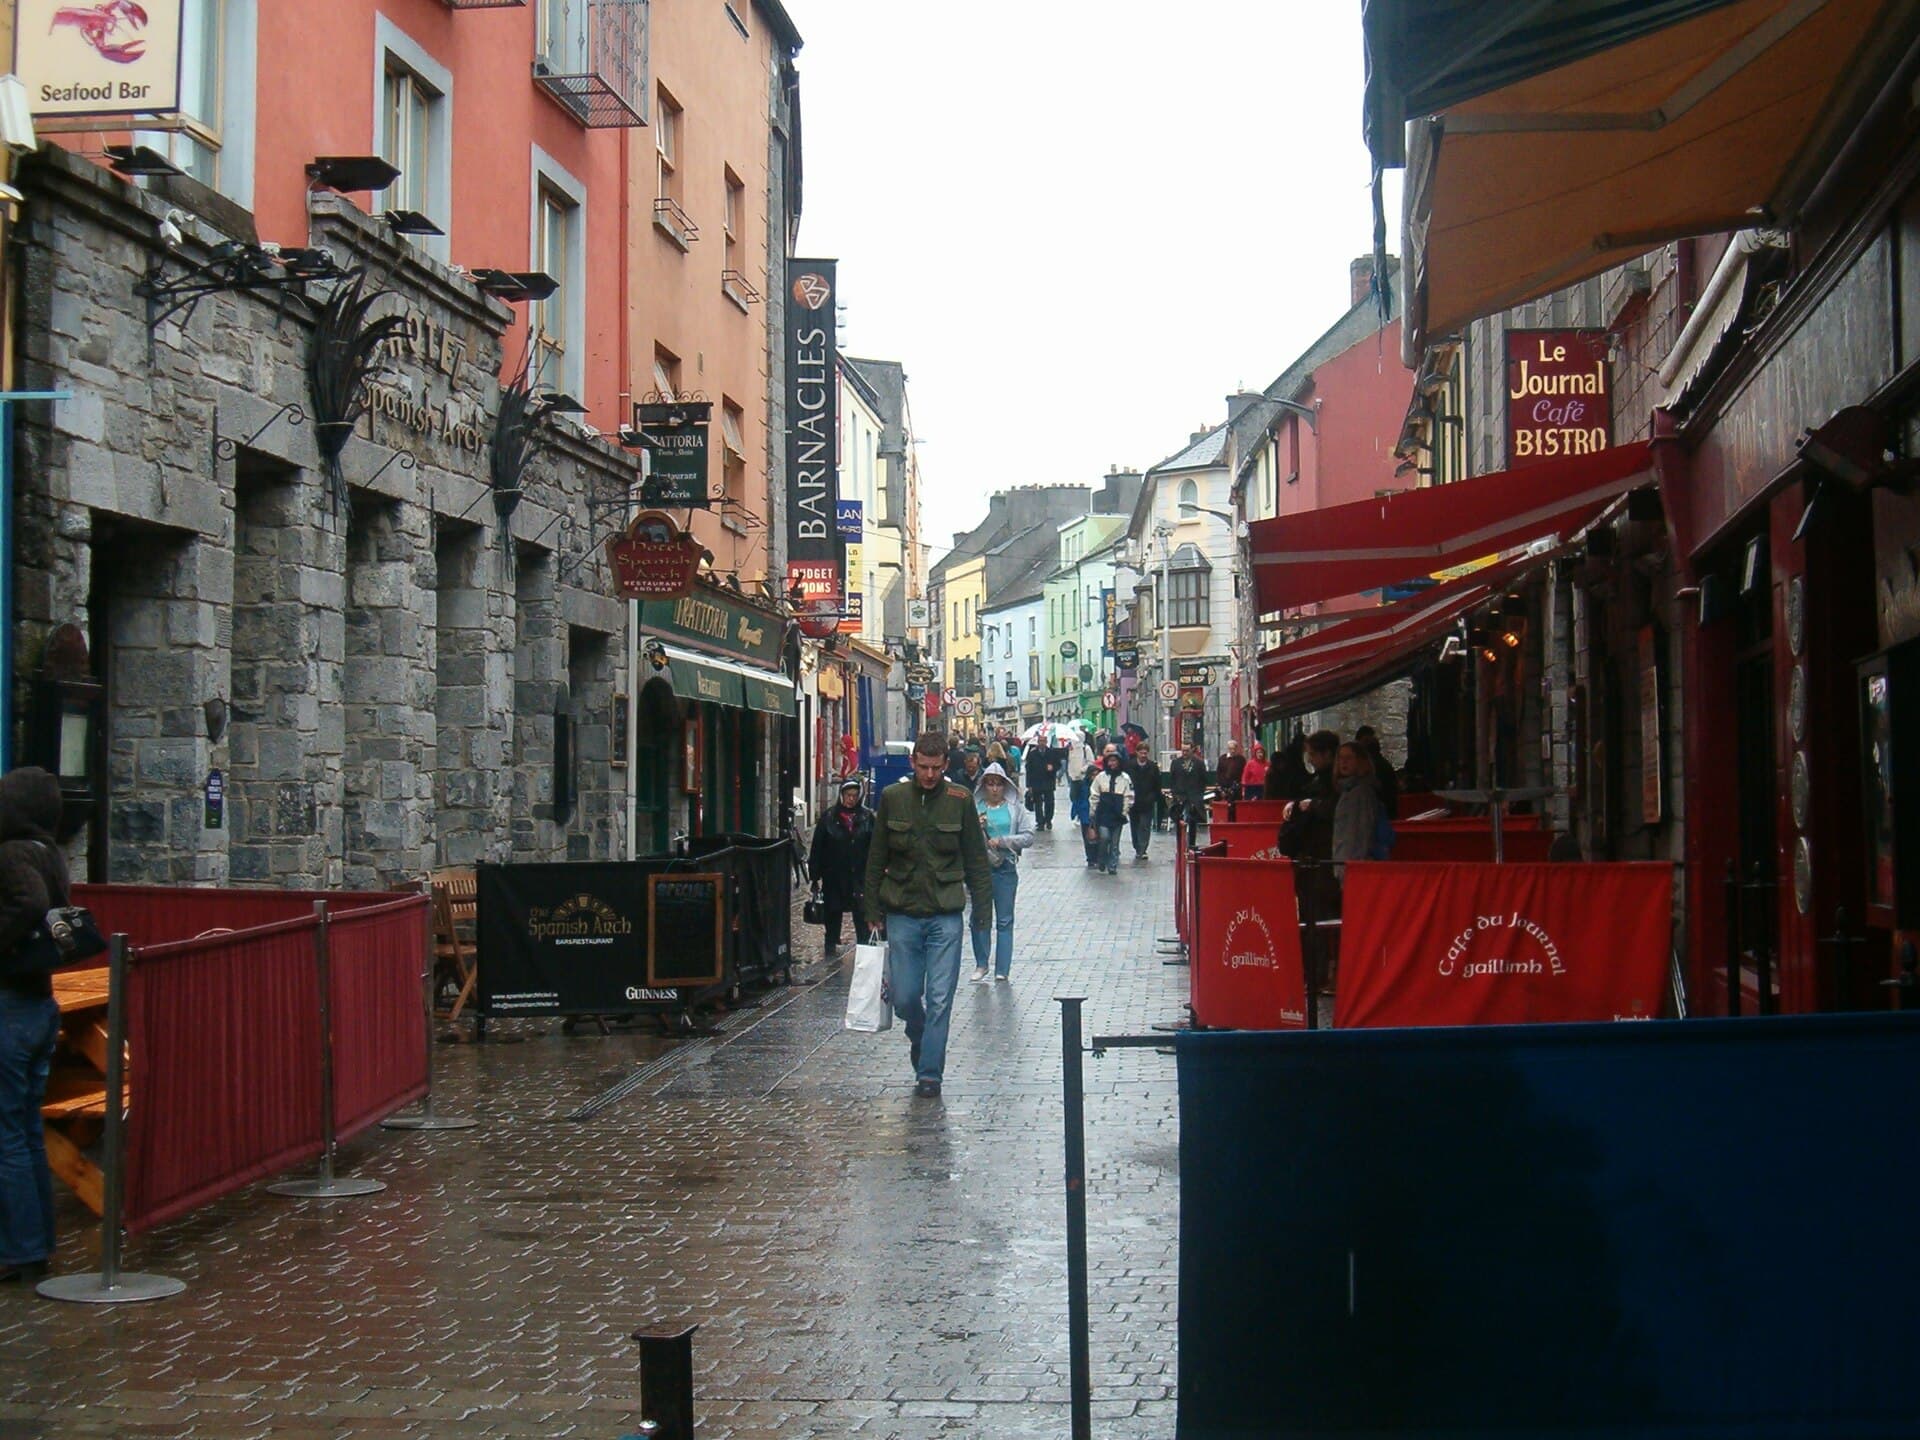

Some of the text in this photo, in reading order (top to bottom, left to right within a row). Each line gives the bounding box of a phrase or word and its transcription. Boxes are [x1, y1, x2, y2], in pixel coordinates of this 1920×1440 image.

[41, 82, 151, 102] Seafood Bar
[1539, 339, 1567, 362] Le
[1510, 360, 1605, 400] Journal
[797, 328, 828, 540] BARNACLES
[1515, 427, 1607, 456] BISTRO
[674, 597, 729, 640] TRATTORIA
[528, 916, 632, 943] Spanish Arch
[1438, 911, 1567, 976] Cafe du Journal
[1463, 958, 1542, 979] gaillimh
[625, 985, 678, 1000] GUINNESS
